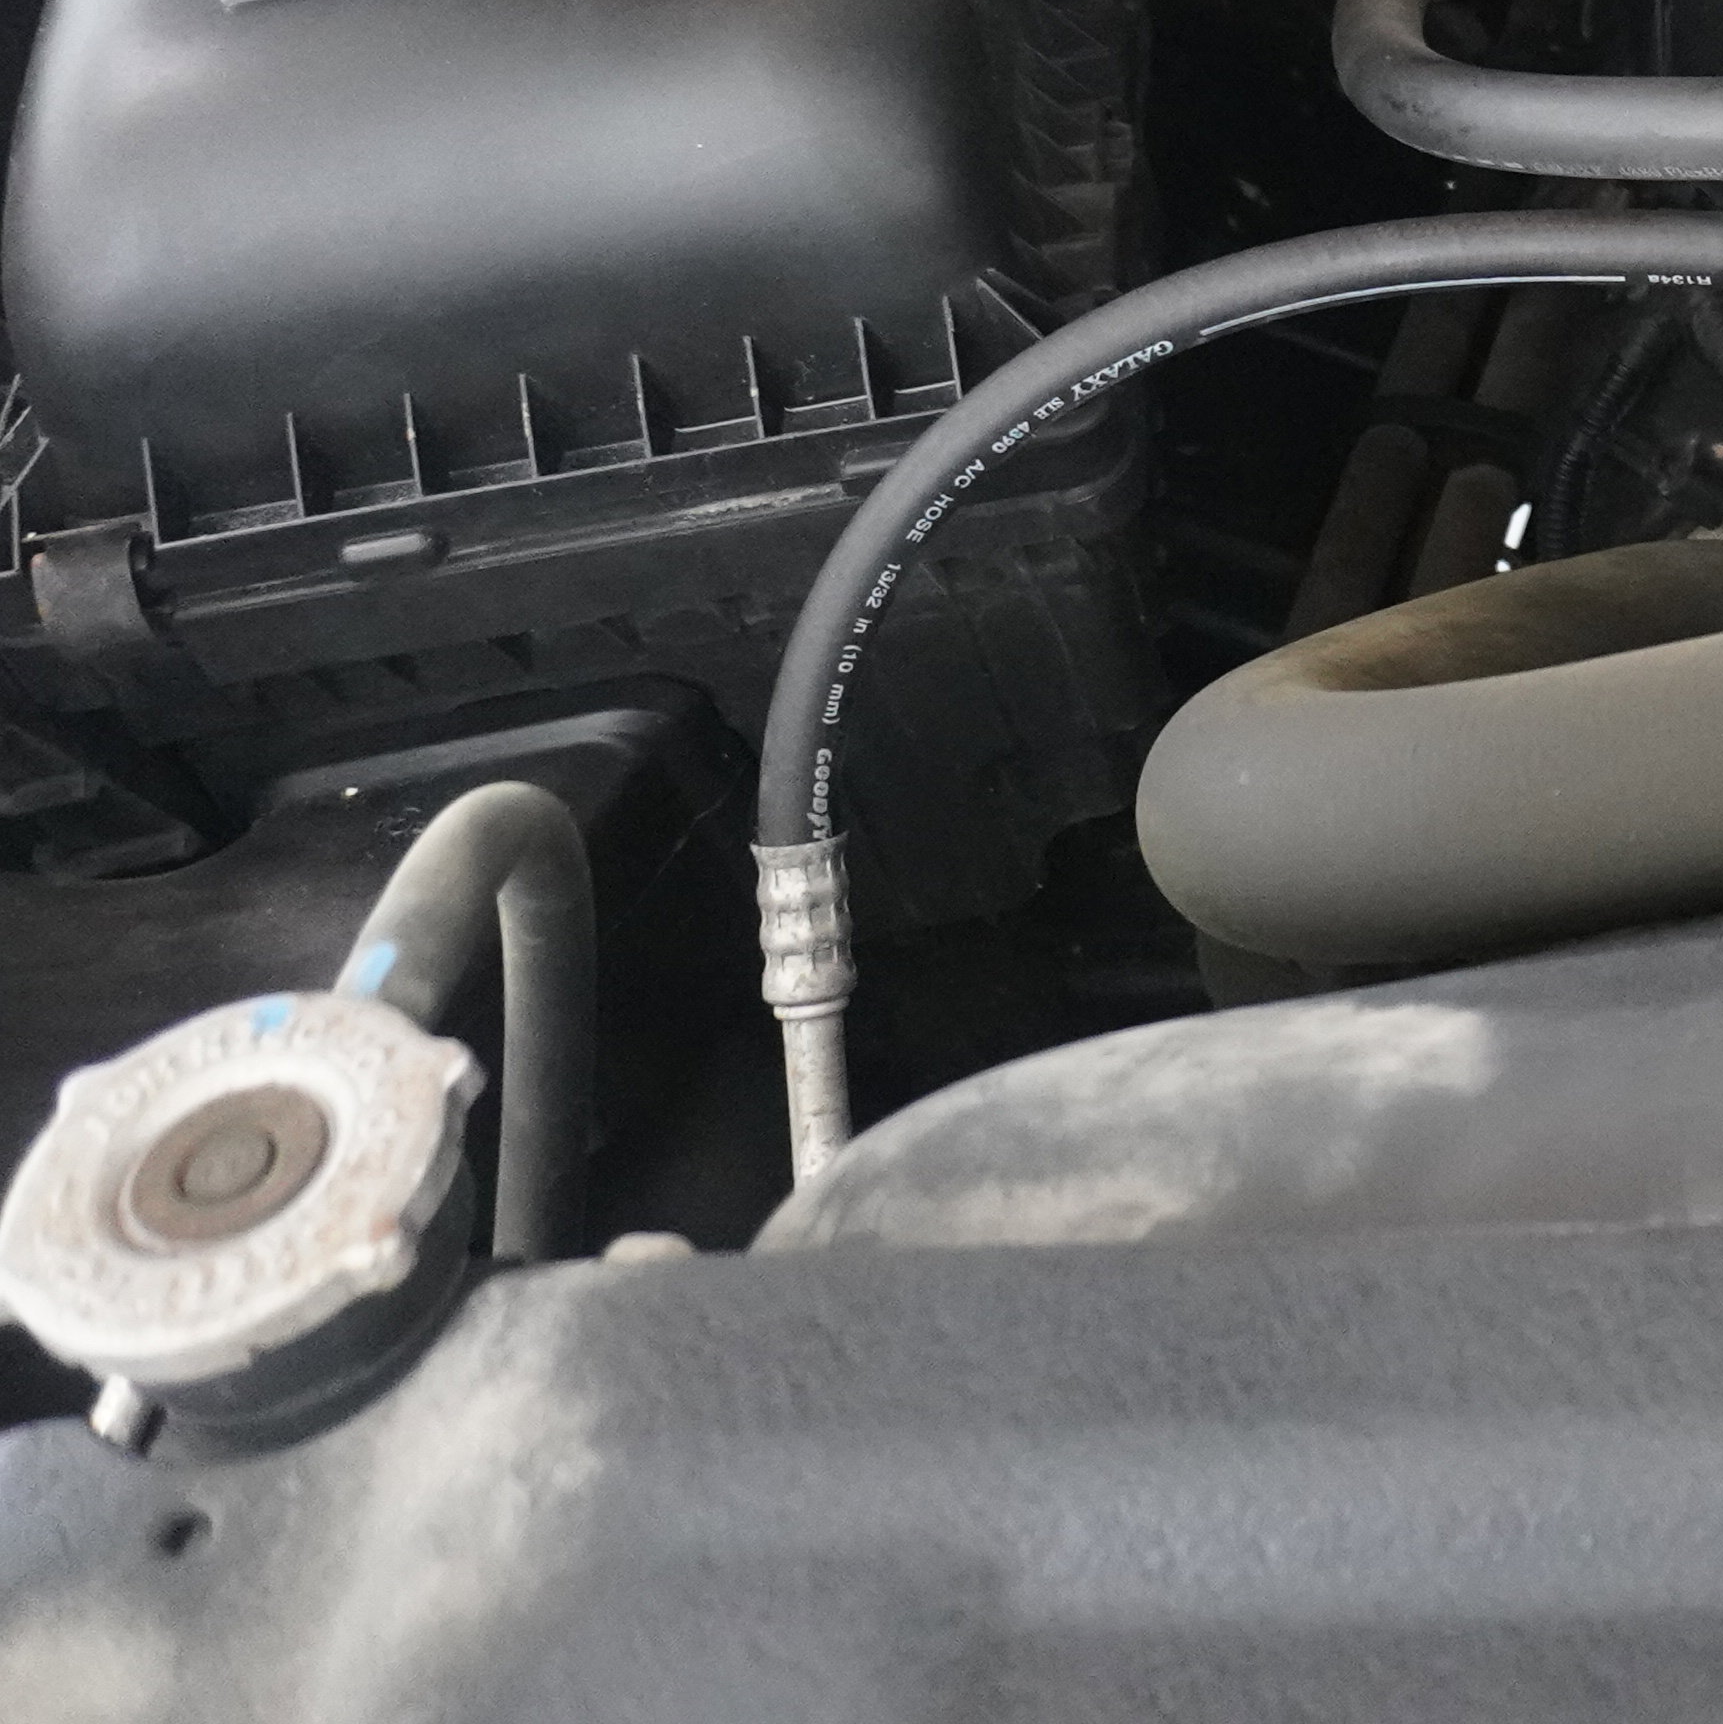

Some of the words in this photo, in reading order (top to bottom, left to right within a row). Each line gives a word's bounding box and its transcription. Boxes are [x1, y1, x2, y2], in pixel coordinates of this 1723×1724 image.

[1647, 274, 1712, 286] R134a
[1071, 340, 1174, 402] GALAXY
[954, 459, 985, 489] A/C
[906, 493, 954, 543] HOSE
[865, 563, 901, 609] 13/32
[853, 617, 873, 634] in
[838, 644, 863, 673] (10
[822, 684, 844, 725] mm)
[806, 747, 833, 840] GOODY
